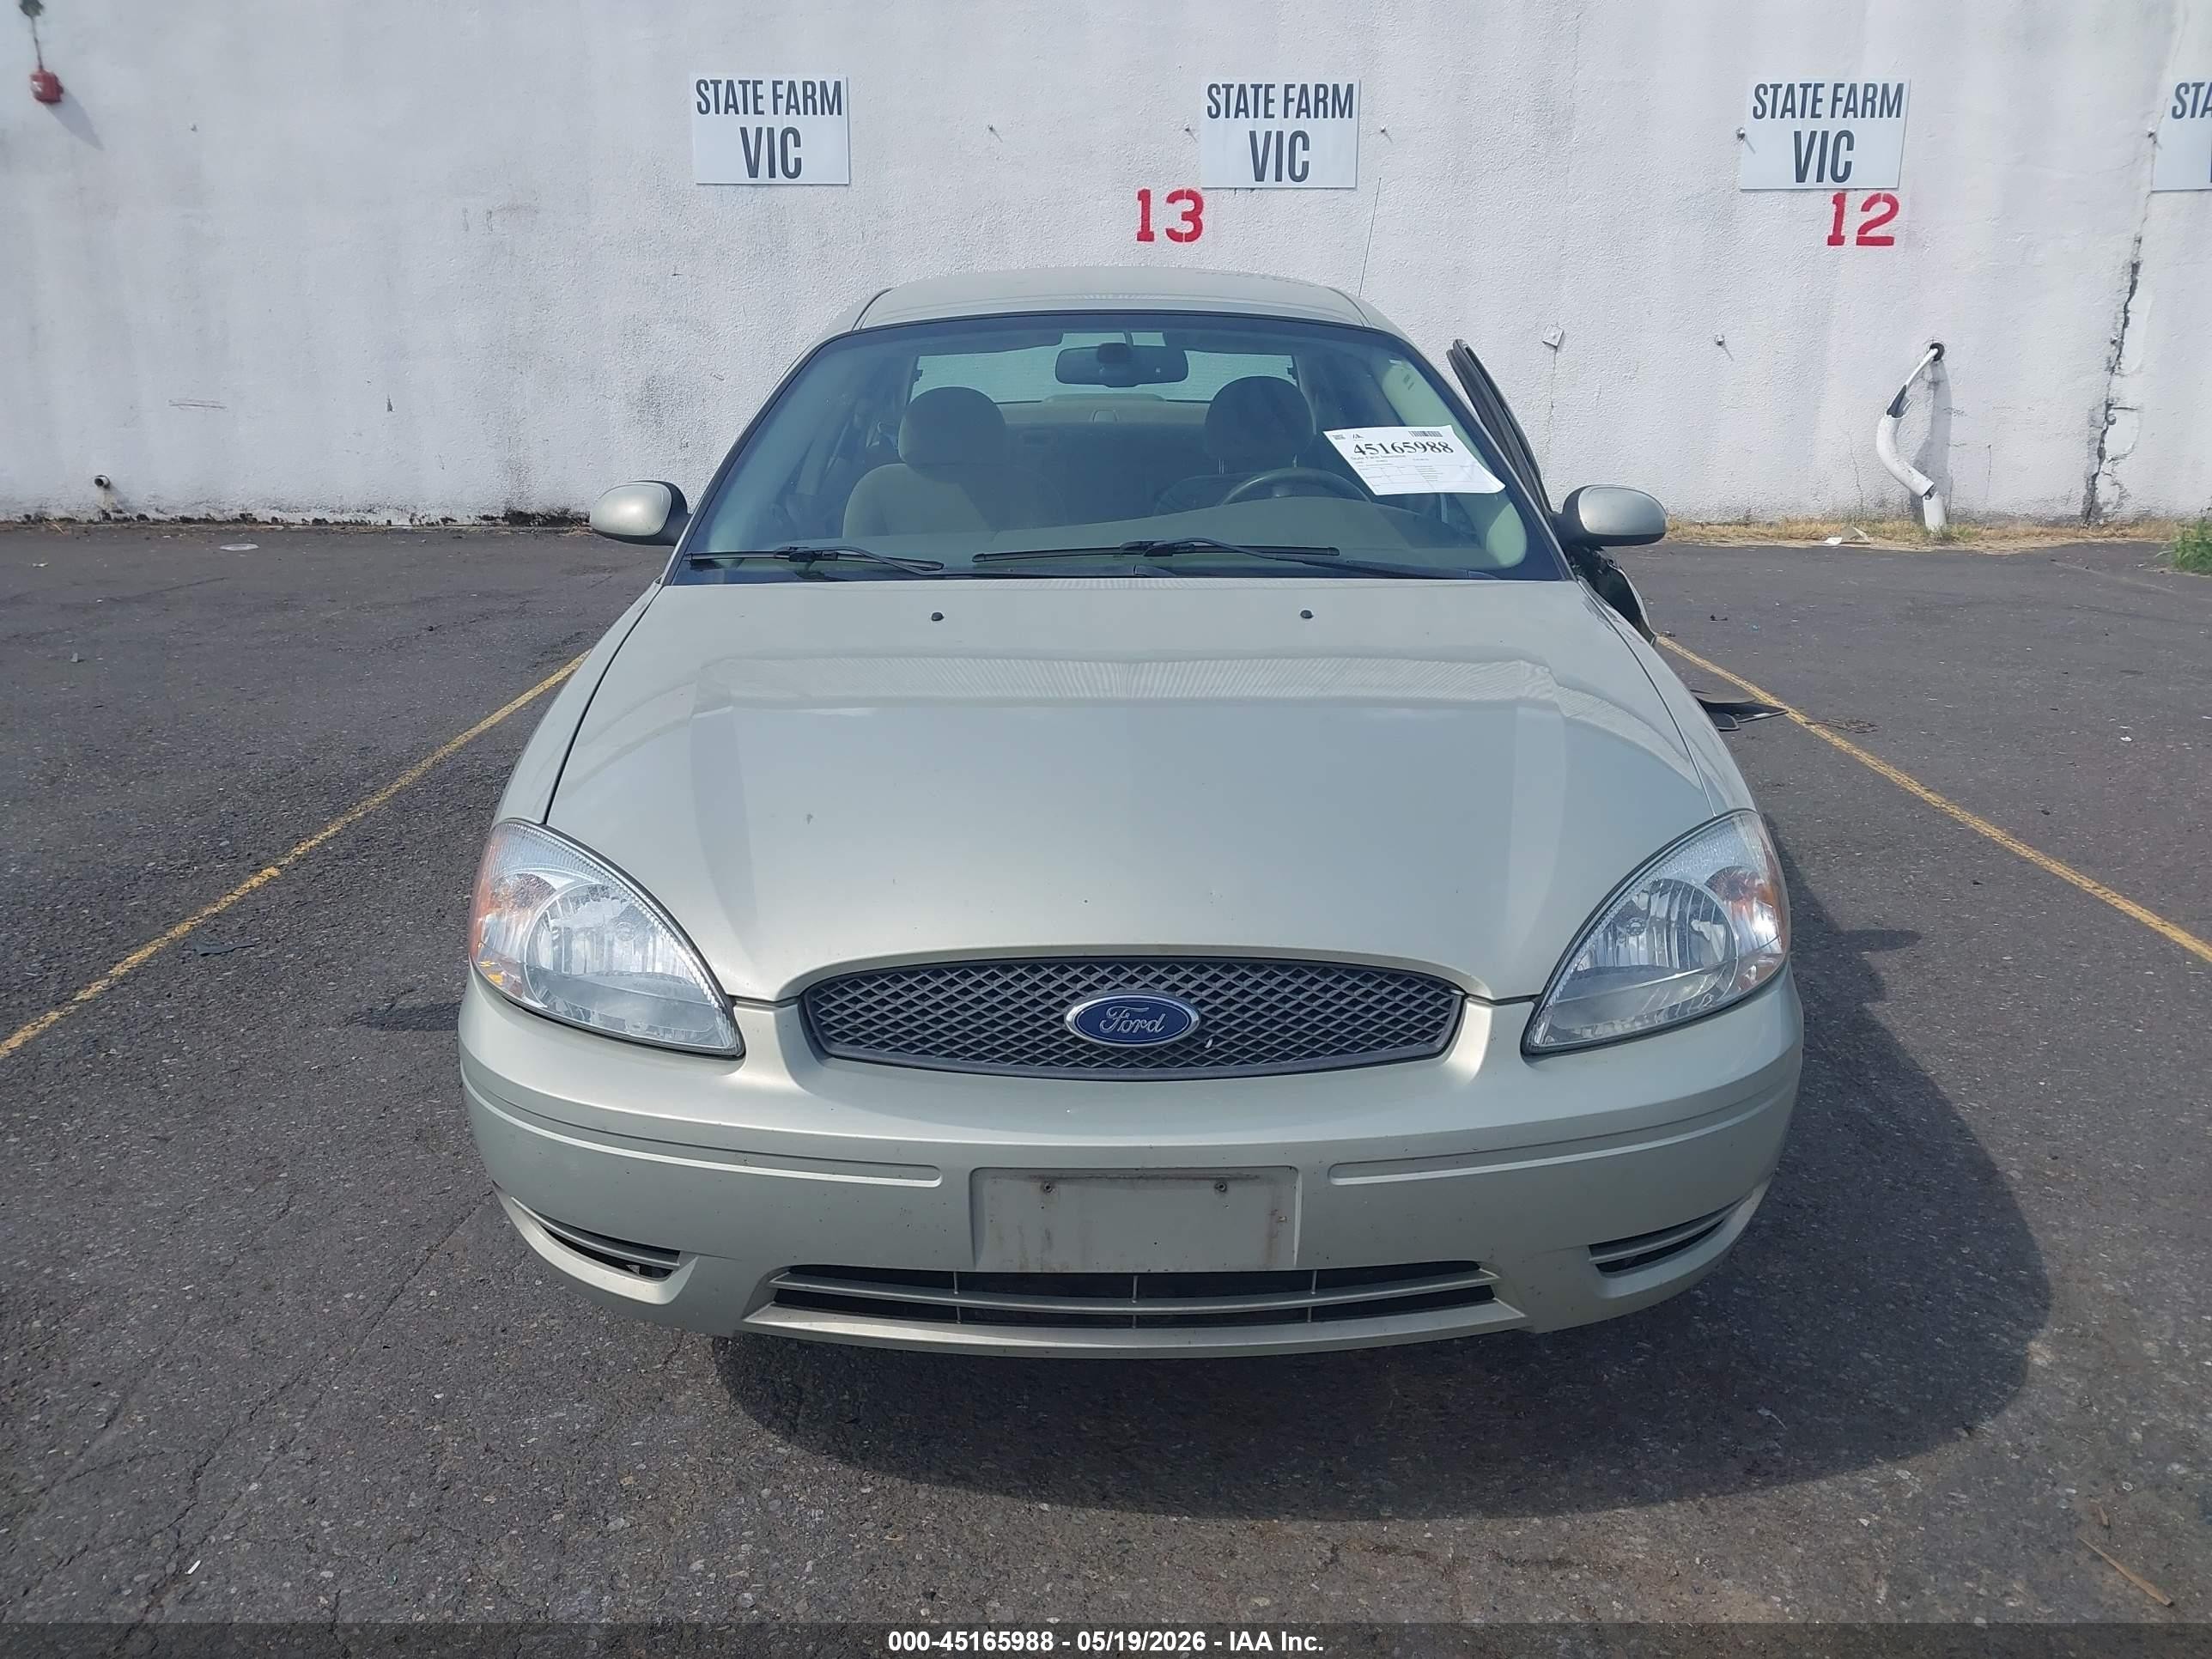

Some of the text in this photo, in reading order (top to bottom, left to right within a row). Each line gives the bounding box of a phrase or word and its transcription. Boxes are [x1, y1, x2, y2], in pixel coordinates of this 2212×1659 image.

[696, 79, 842, 116] STATE FARM
[1206, 83, 1354, 118] STATE FARM
[1753, 82, 1904, 119] STATE FARM
[739, 126, 802, 179] VIC
[1249, 130, 1310, 182] VIC
[1794, 130, 1855, 183] VIC
[1136, 188, 1204, 242] 13
[1827, 192, 1899, 246] 12
[1353, 441, 1455, 455] 45165988
[1099, 1006, 1166, 1033] Ford
